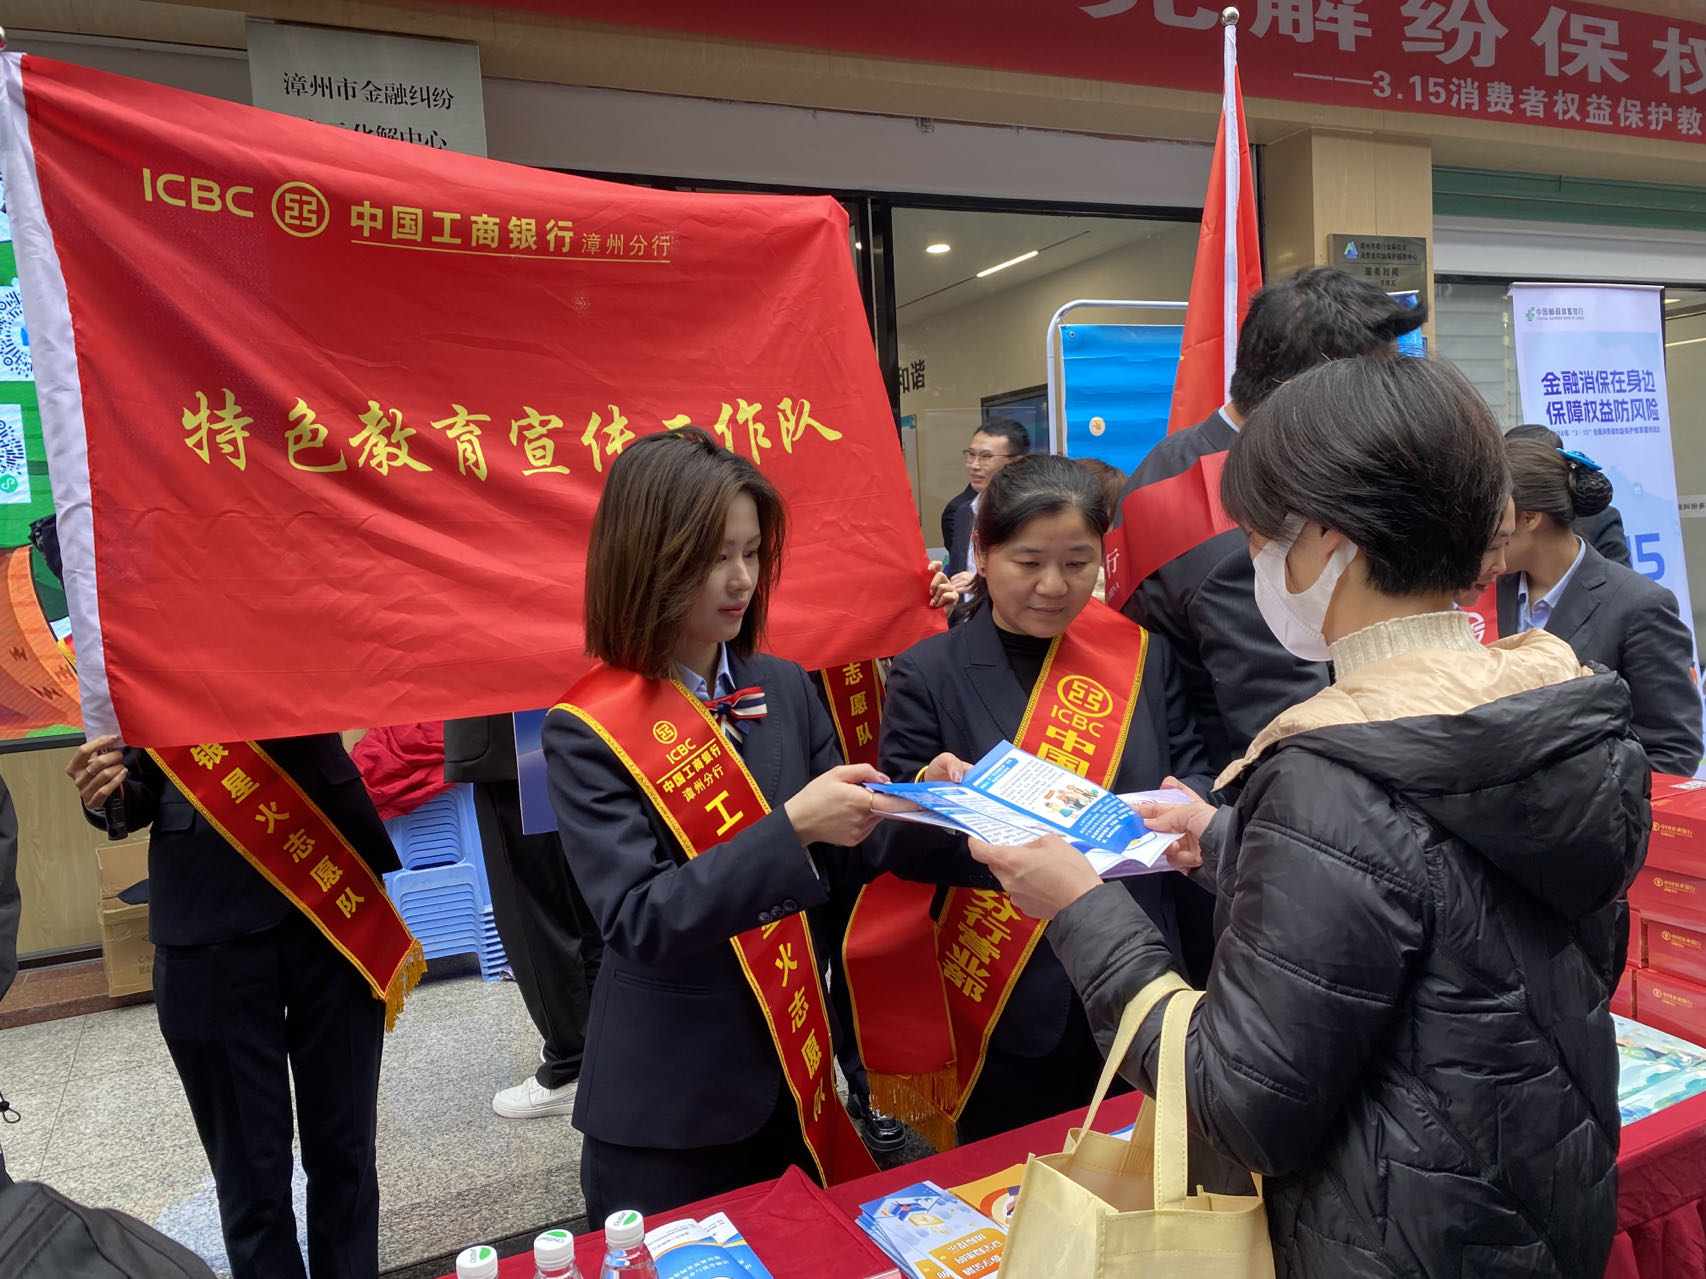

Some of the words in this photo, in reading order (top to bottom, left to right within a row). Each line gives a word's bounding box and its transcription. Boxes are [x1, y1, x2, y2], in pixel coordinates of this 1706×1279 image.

[283, 72, 454, 110] 漳州市金融纠纷
[143, 168, 254, 219] ICBC
[350, 200, 574, 254] 中国工商银行
[581, 232, 671, 258] 漳州分行
[898, 359, 926, 394] 和谐
[1541, 368, 1656, 397] 金融消保在身边
[1546, 398, 1660, 426] 保障权益防风险
[1105, 547, 1121, 579] 行
[843, 661, 874, 748] 志愿队
[1049, 705, 1105, 739] ICBC
[662, 743, 721, 794] 中国工商银行
[665, 737, 697, 765] ICBC
[682, 764, 724, 803] 漳州分行
[703, 789, 744, 837] 工
